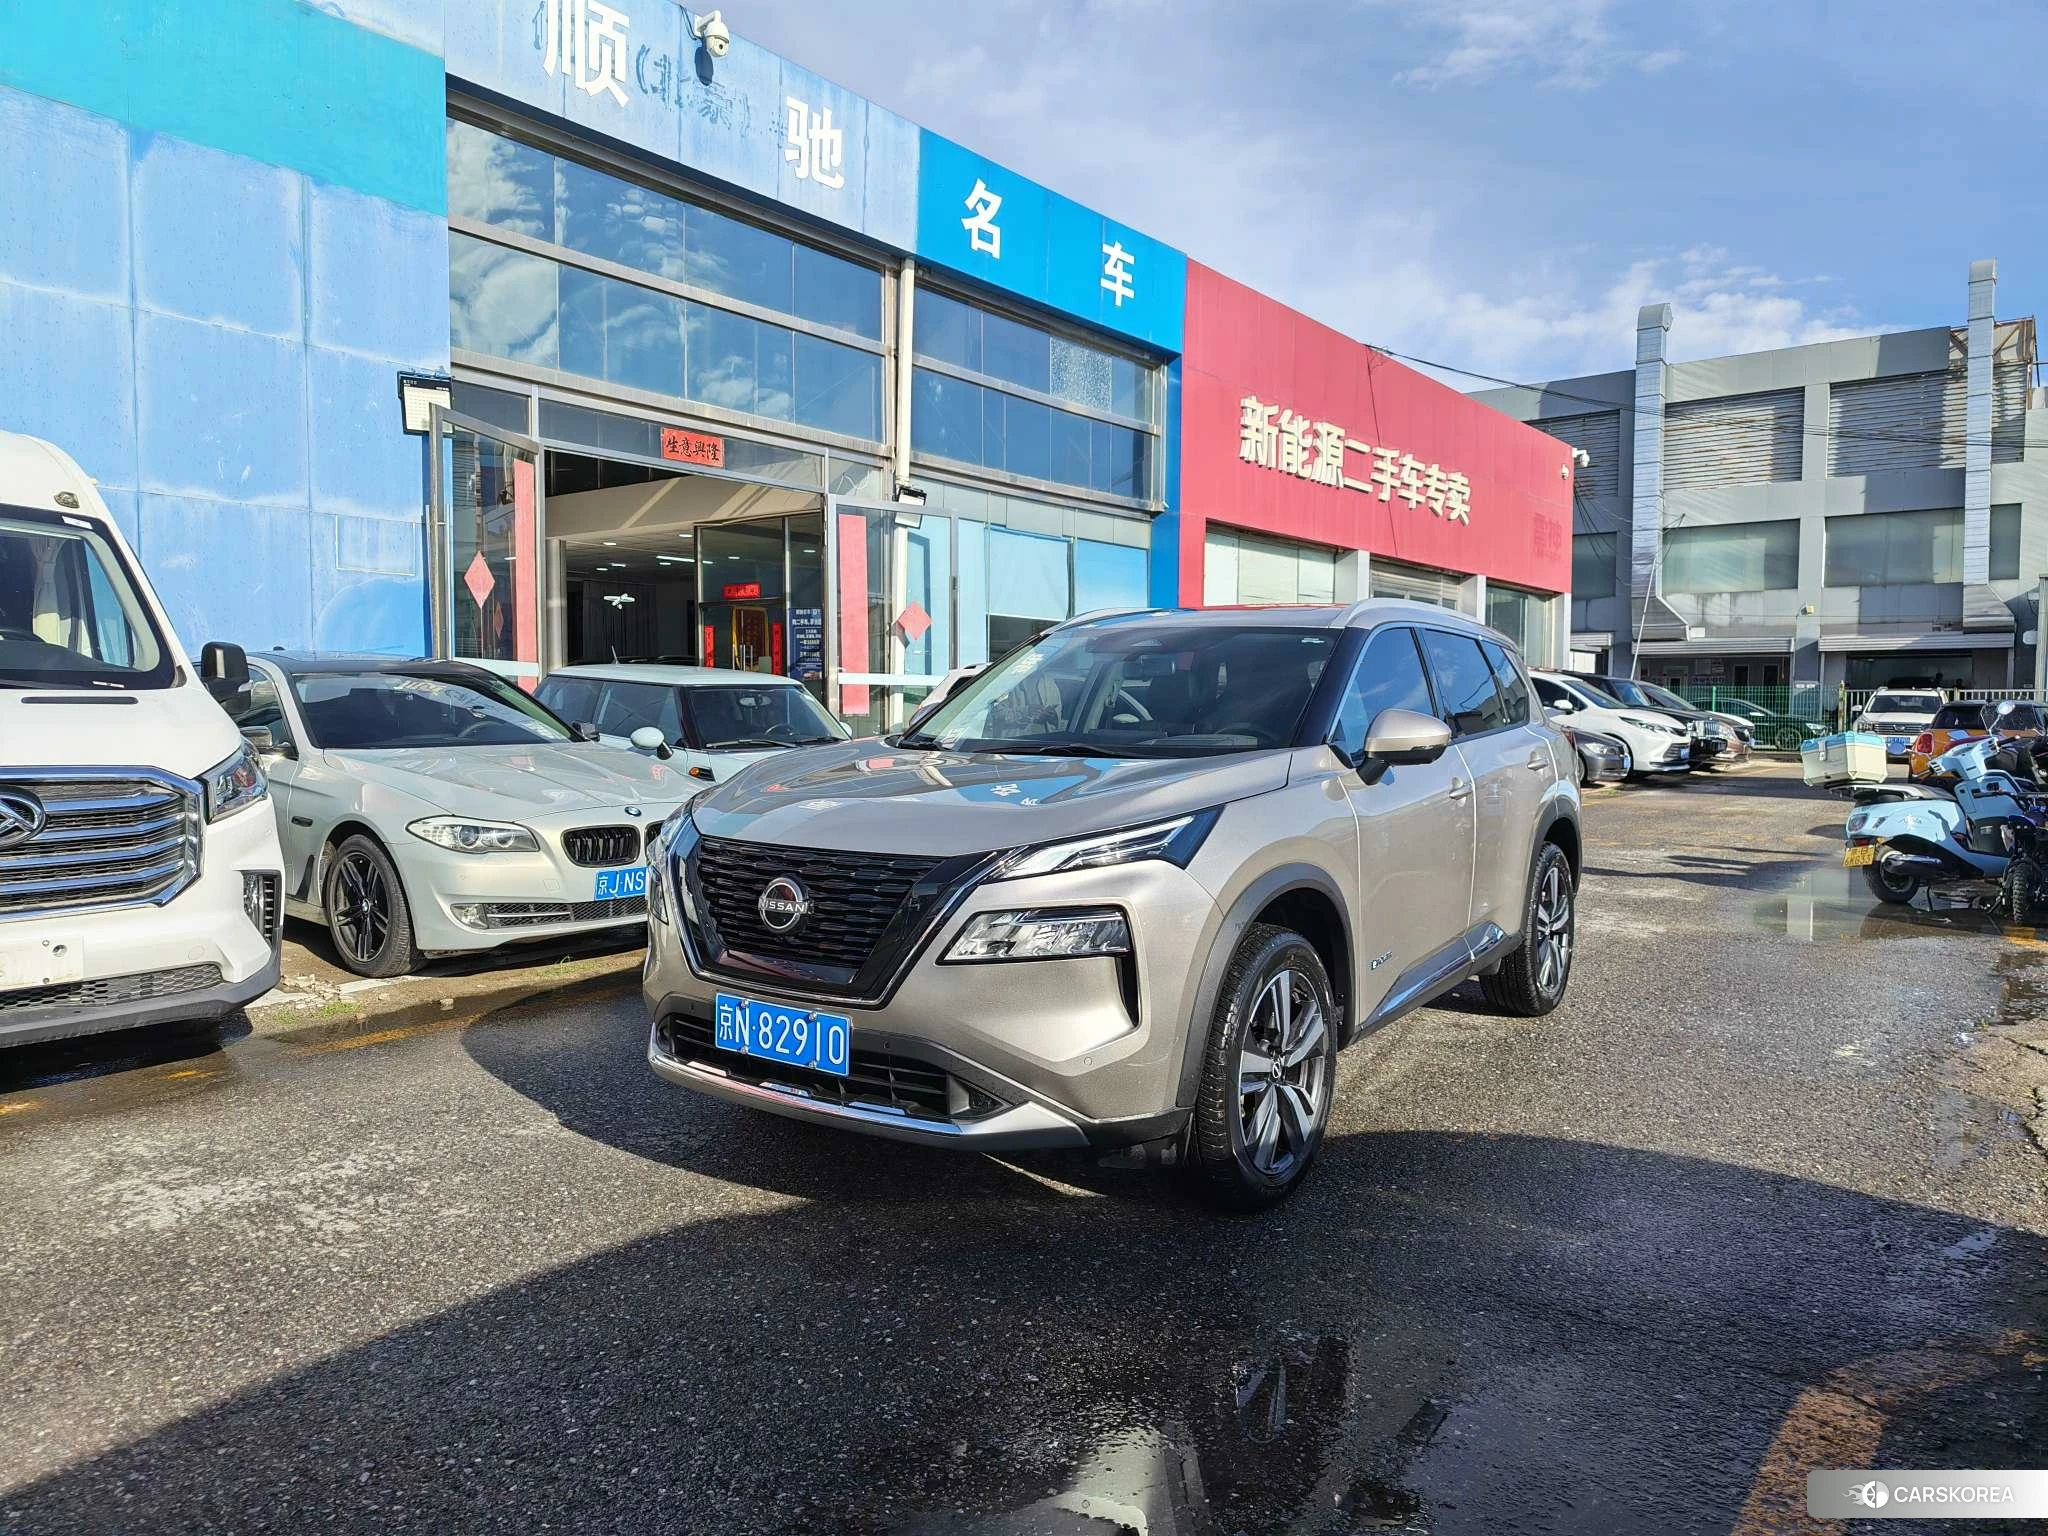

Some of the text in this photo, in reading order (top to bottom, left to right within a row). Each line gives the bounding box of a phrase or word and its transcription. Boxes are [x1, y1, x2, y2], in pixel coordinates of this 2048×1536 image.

[665, 435, 720, 461] 生意興隆
[1239, 395, 1471, 527] 新能源二手车专卖
[759, 899, 806, 912] NISSAN
